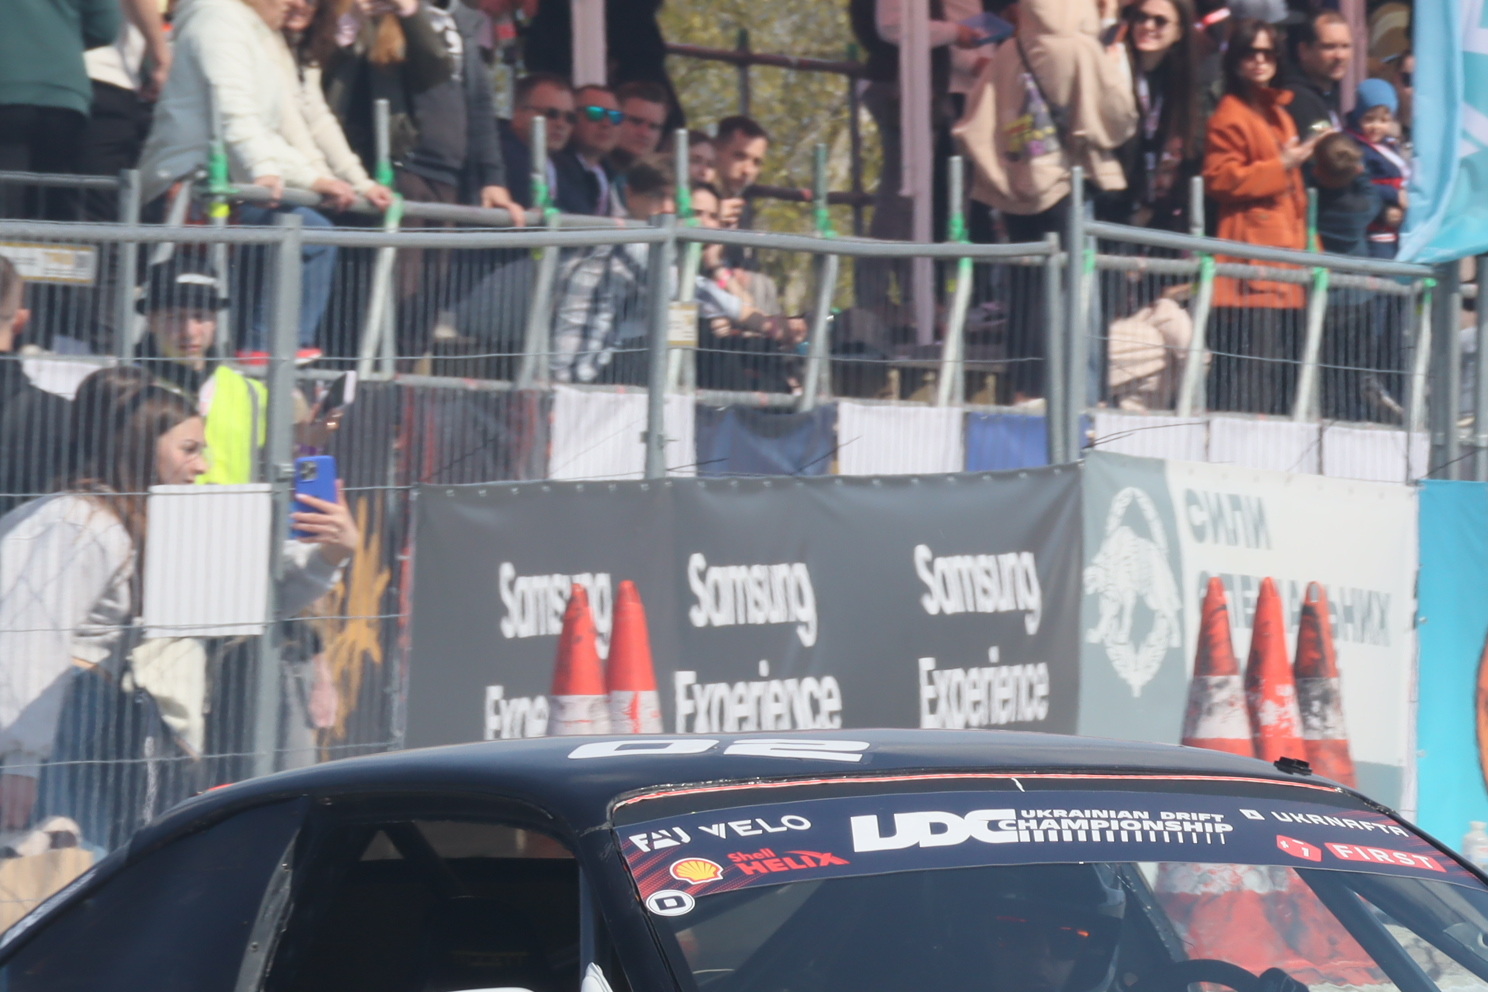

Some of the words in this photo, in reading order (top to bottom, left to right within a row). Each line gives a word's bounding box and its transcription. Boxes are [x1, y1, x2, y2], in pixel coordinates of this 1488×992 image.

[688, 552, 817, 647] Samsung
[914, 544, 1041, 635] Samsung
[674, 660, 842, 735] Experience
[918, 647, 1050, 728] Experience
[698, 814, 812, 839] VELO
[998, 818, 1234, 834] CHAMPIONSHIP
[1020, 808, 1150, 821] UKRAINIAN
[1160, 811, 1225, 823] DRIFT
[727, 847, 777, 863] Shell
[734, 850, 851, 876] HELIX
[1332, 844, 1435, 870] FIRST
